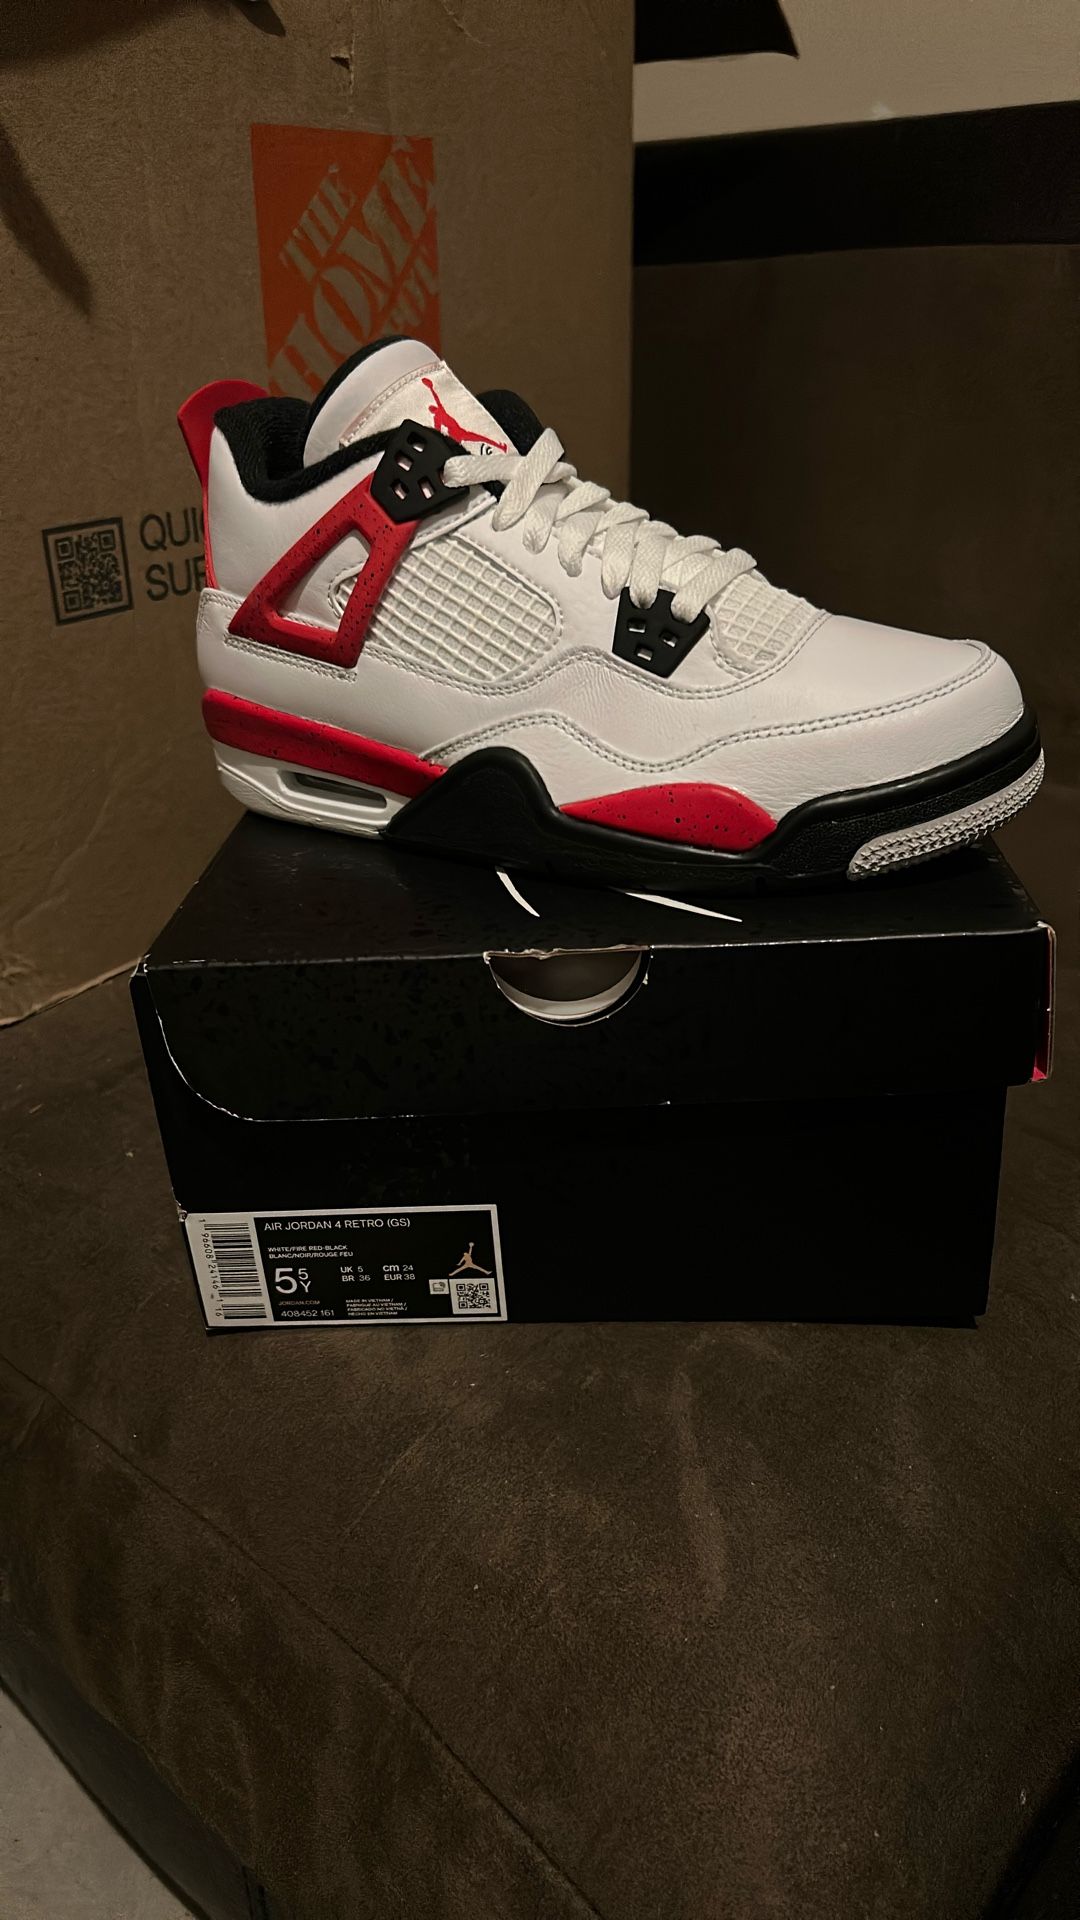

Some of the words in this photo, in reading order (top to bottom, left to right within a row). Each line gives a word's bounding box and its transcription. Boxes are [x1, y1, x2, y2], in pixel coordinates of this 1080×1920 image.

[279, 163, 358, 283] THE
[264, 1221, 283, 1231] AIR
[285, 1220, 332, 1231] JORDAN
[334, 1220, 342, 1229] 4
[344, 1218, 384, 1229] RETRO
[387, 1217, 411, 1228] (GS)
[268, 1251, 339, 1259] BLANC/NOIR/ROUGE
[298, 1268, 309, 1280] 5
[357, 1265, 364, 1273] 5
[402, 1264, 414, 1272] 24
[275, 1267, 298, 1294] 5
[299, 1280, 312, 1293] Y
[281, 1309, 318, 1318] 408452
[321, 1309, 335, 1317] 161
